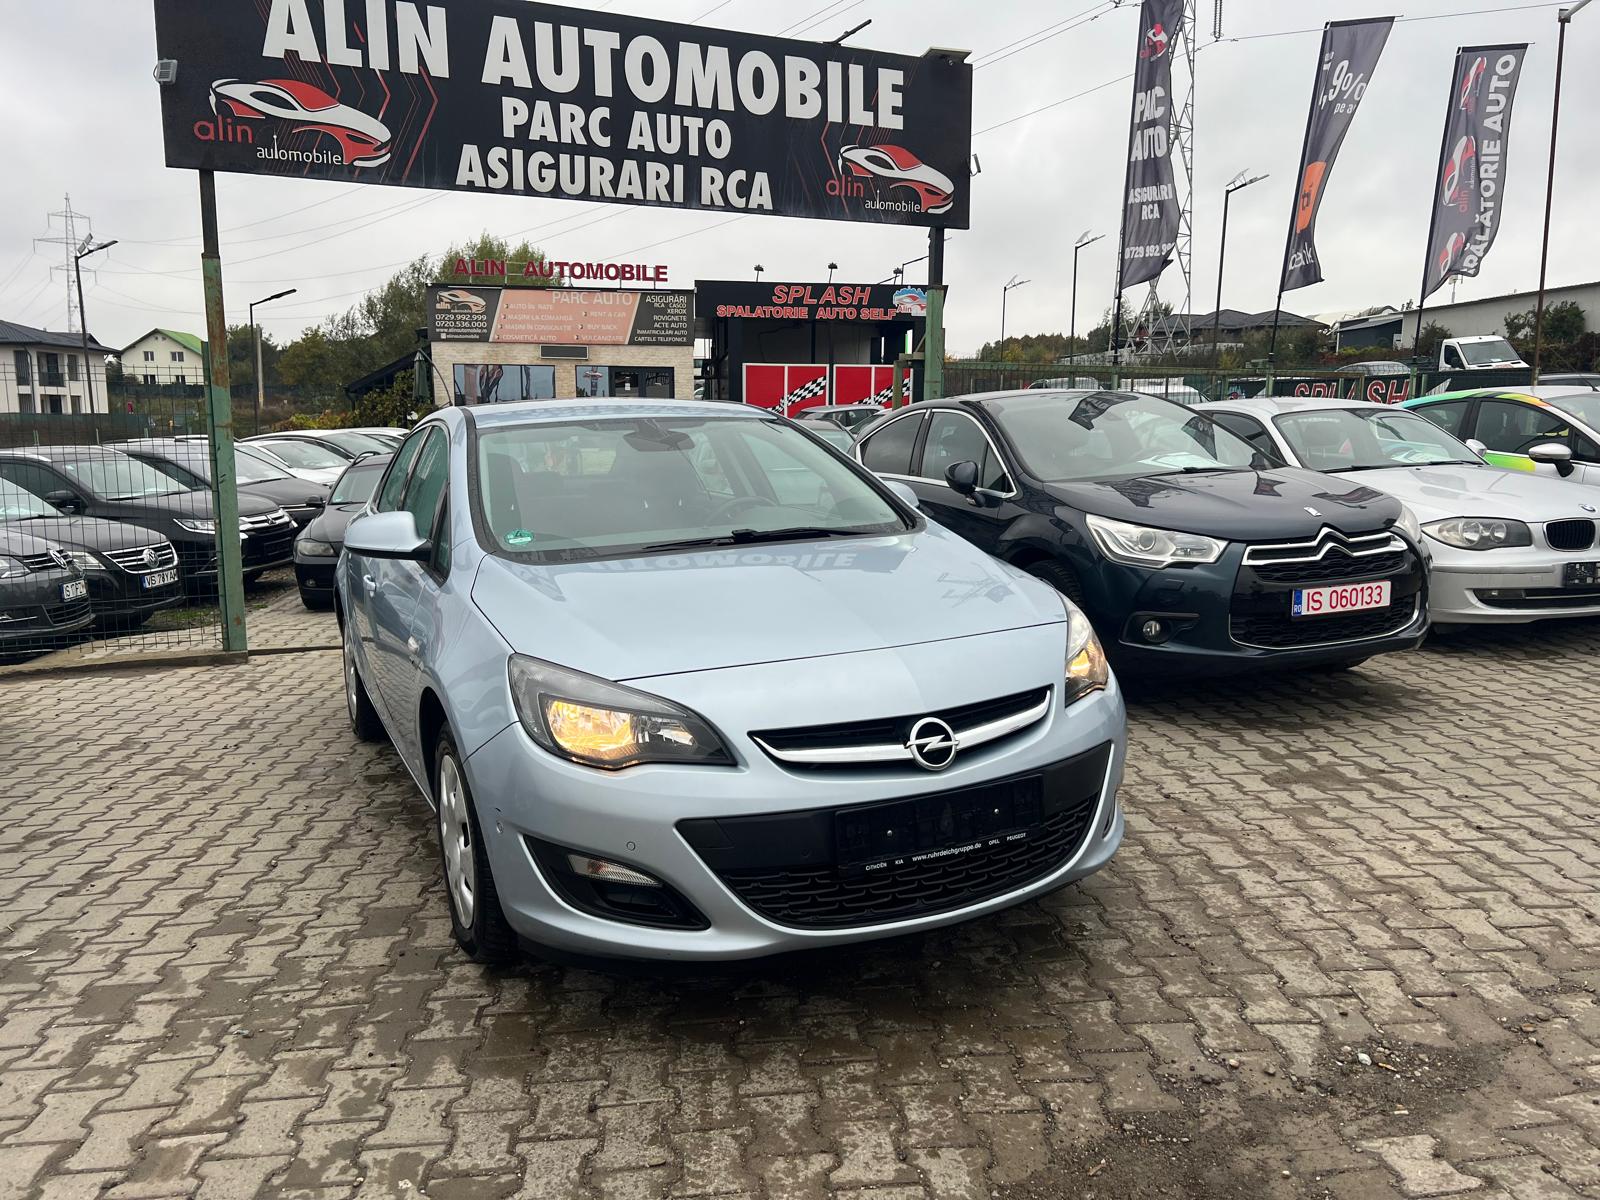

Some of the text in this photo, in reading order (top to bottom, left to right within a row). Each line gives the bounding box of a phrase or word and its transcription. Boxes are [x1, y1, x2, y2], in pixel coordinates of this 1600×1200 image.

[262, 0, 904, 130] ALIN AUTOMOBILE
[1133, 86, 1166, 124] PAC
[1483, 54, 1516, 134] AUTO
[193, 116, 254, 144] alin
[501, 96, 732, 160] PARC AUTO
[256, 138, 342, 166] automobile
[1130, 125, 1168, 162] AUTO
[455, 144, 774, 211] ASIGURARI RCA
[826, 176, 865, 199] alin
[1141, 203, 1161, 221] RCA
[454, 258, 668, 282] ALIN AUTOMOBILE
[551, 291, 632, 306] PARC AUTO
[771, 284, 872, 306] SPLASH
[716, 304, 897, 320] SPALATORIE AUTO SELF
[1293, 604, 1302, 613] RO
[1306, 585, 1383, 612] IS 060133
[911, 842, 982, 862] www.ruhrdeichgruppe.de
[1006, 832, 1027, 842] PEUGEOT
